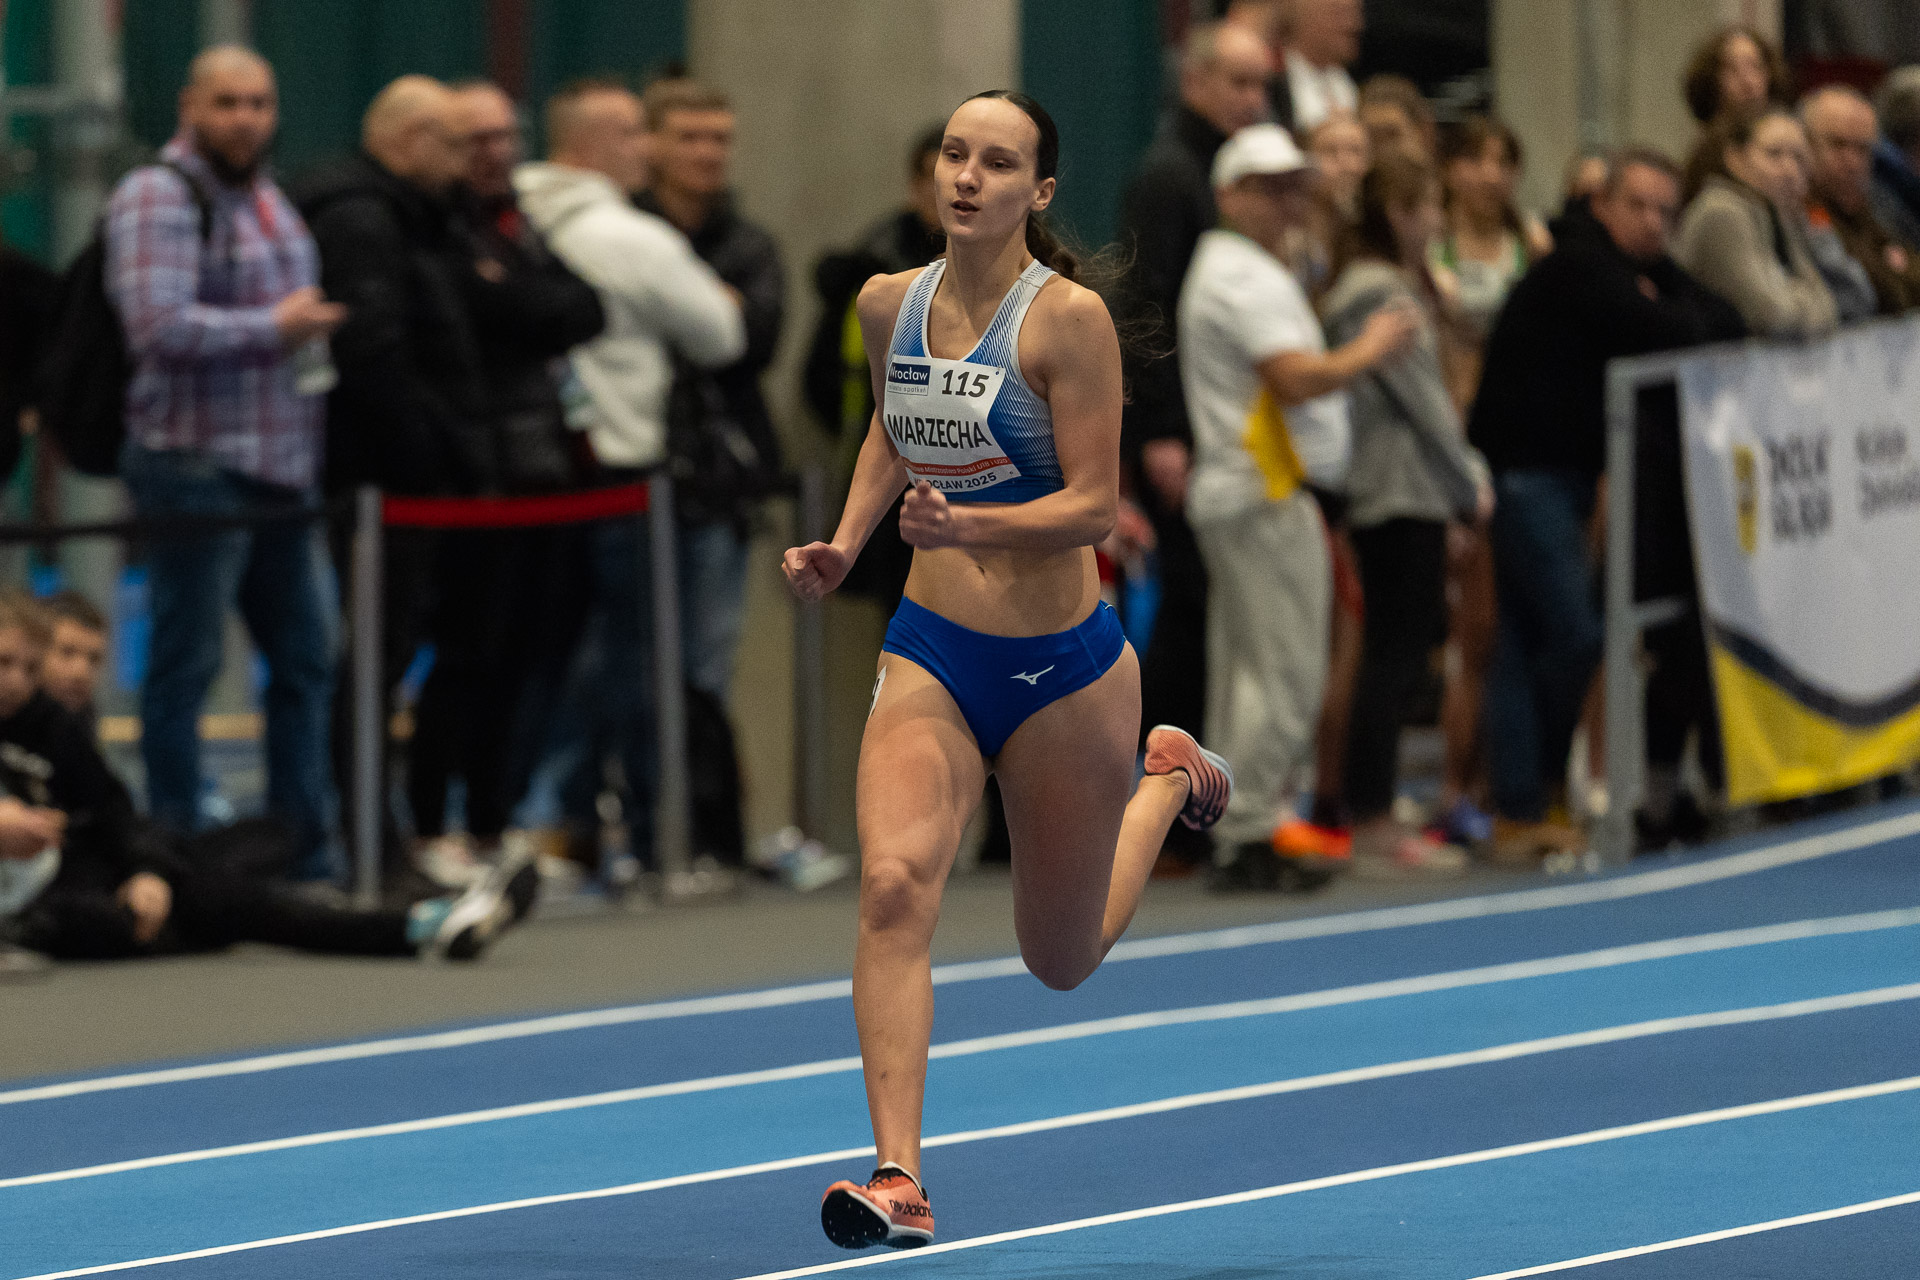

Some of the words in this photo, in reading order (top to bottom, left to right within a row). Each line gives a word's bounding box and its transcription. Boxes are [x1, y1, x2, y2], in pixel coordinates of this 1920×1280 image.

[890, 366, 928, 380] Wrocław
[942, 369, 989, 397] 115
[887, 413, 992, 449] WARZECHA
[977, 460, 990, 469] U18
[913, 477, 963, 489] OCŁAW
[965, 472, 997, 488] 2025
